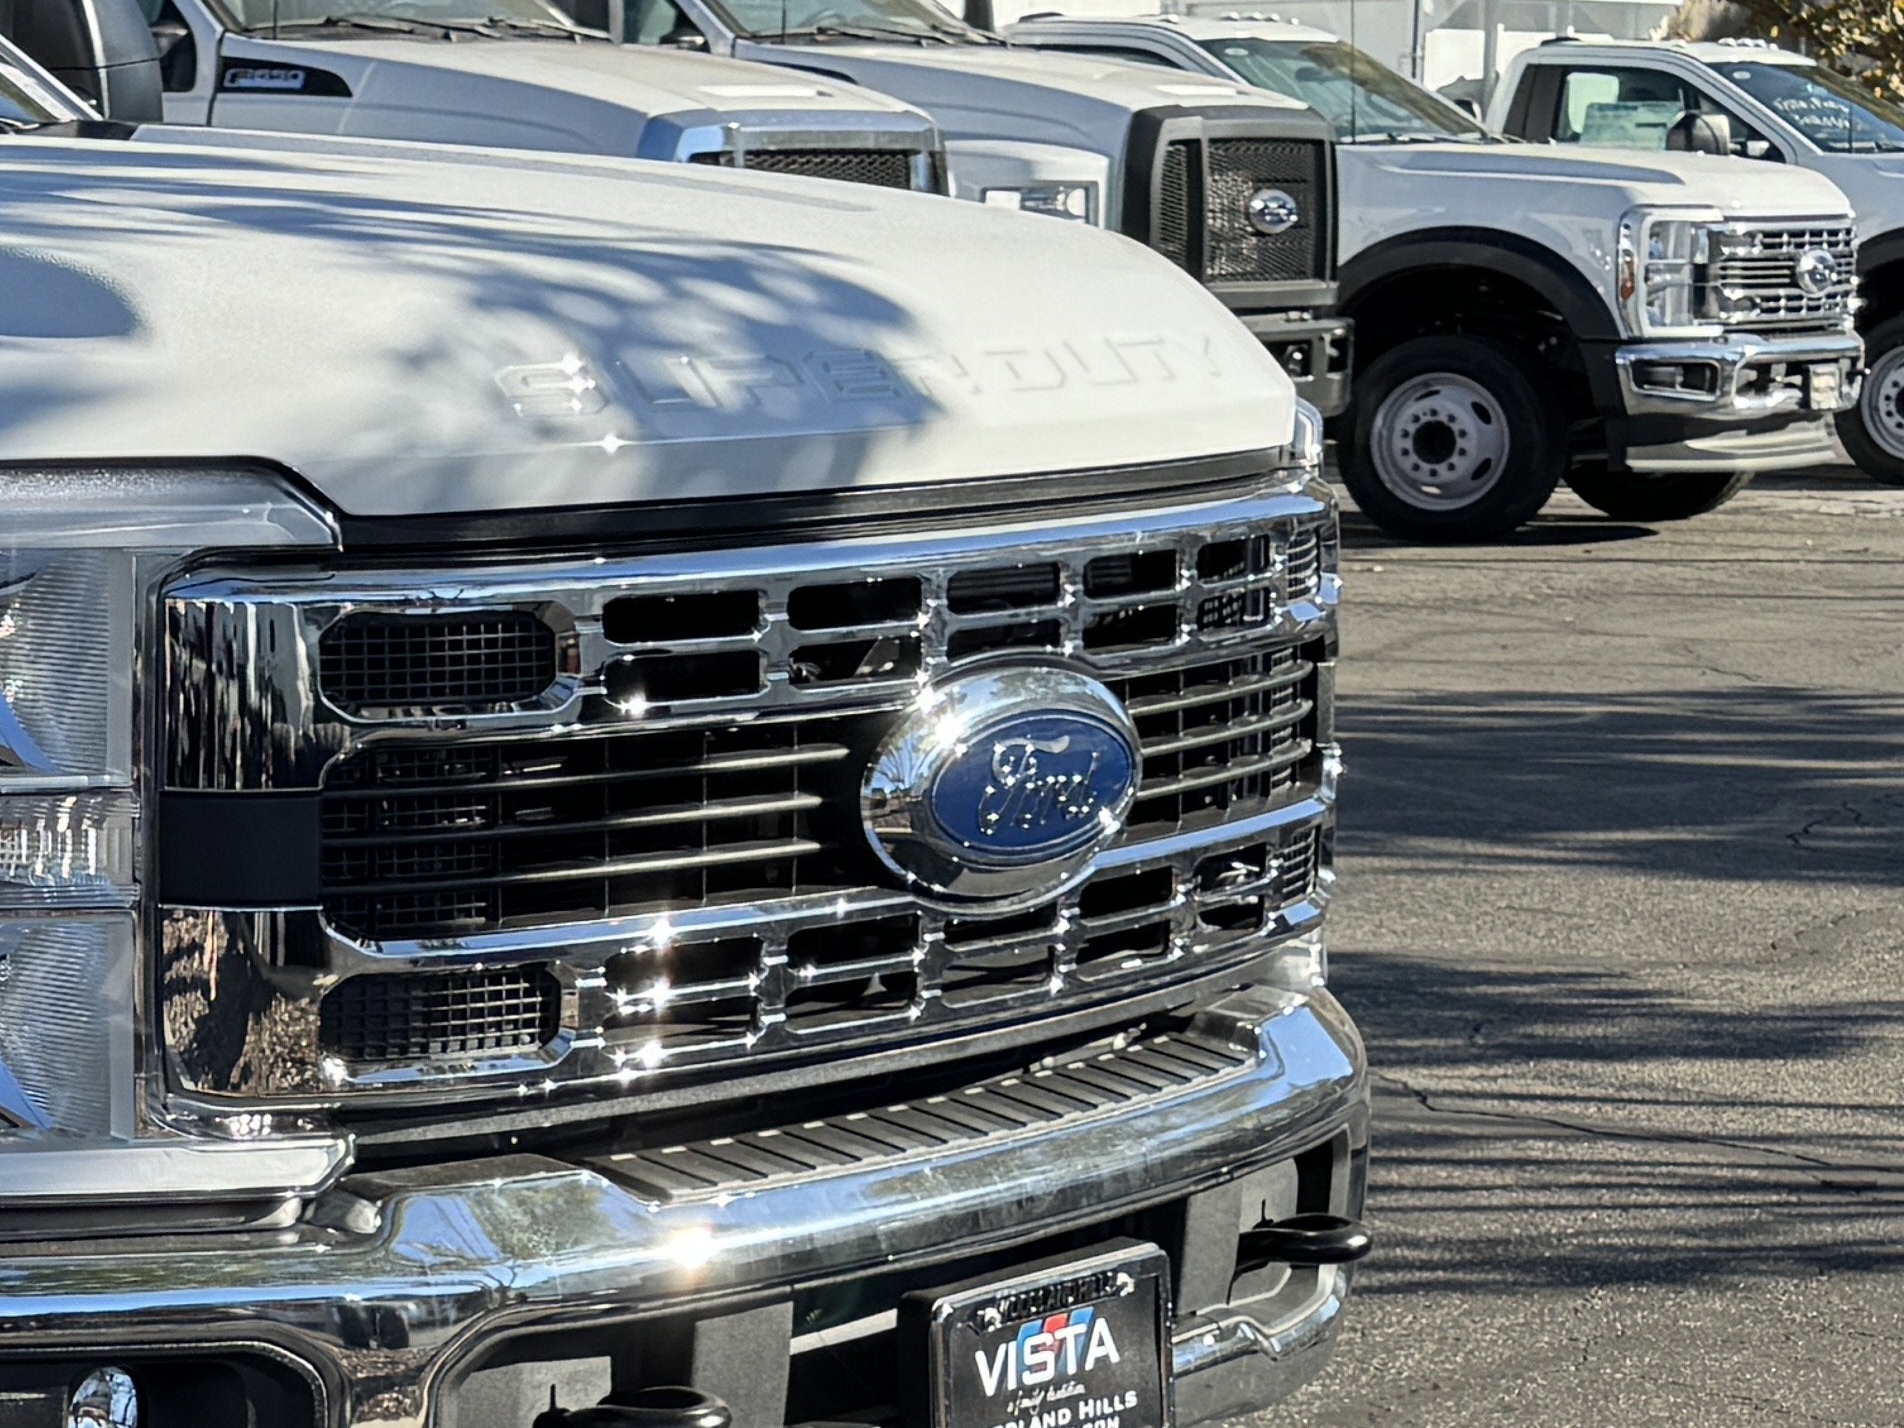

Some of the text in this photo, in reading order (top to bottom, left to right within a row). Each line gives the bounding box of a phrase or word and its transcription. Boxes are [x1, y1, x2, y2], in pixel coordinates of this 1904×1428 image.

[977, 735, 1100, 837] Ford
[974, 1317, 1121, 1398] VISTA
[1078, 1389, 1139, 1420] HILLS
